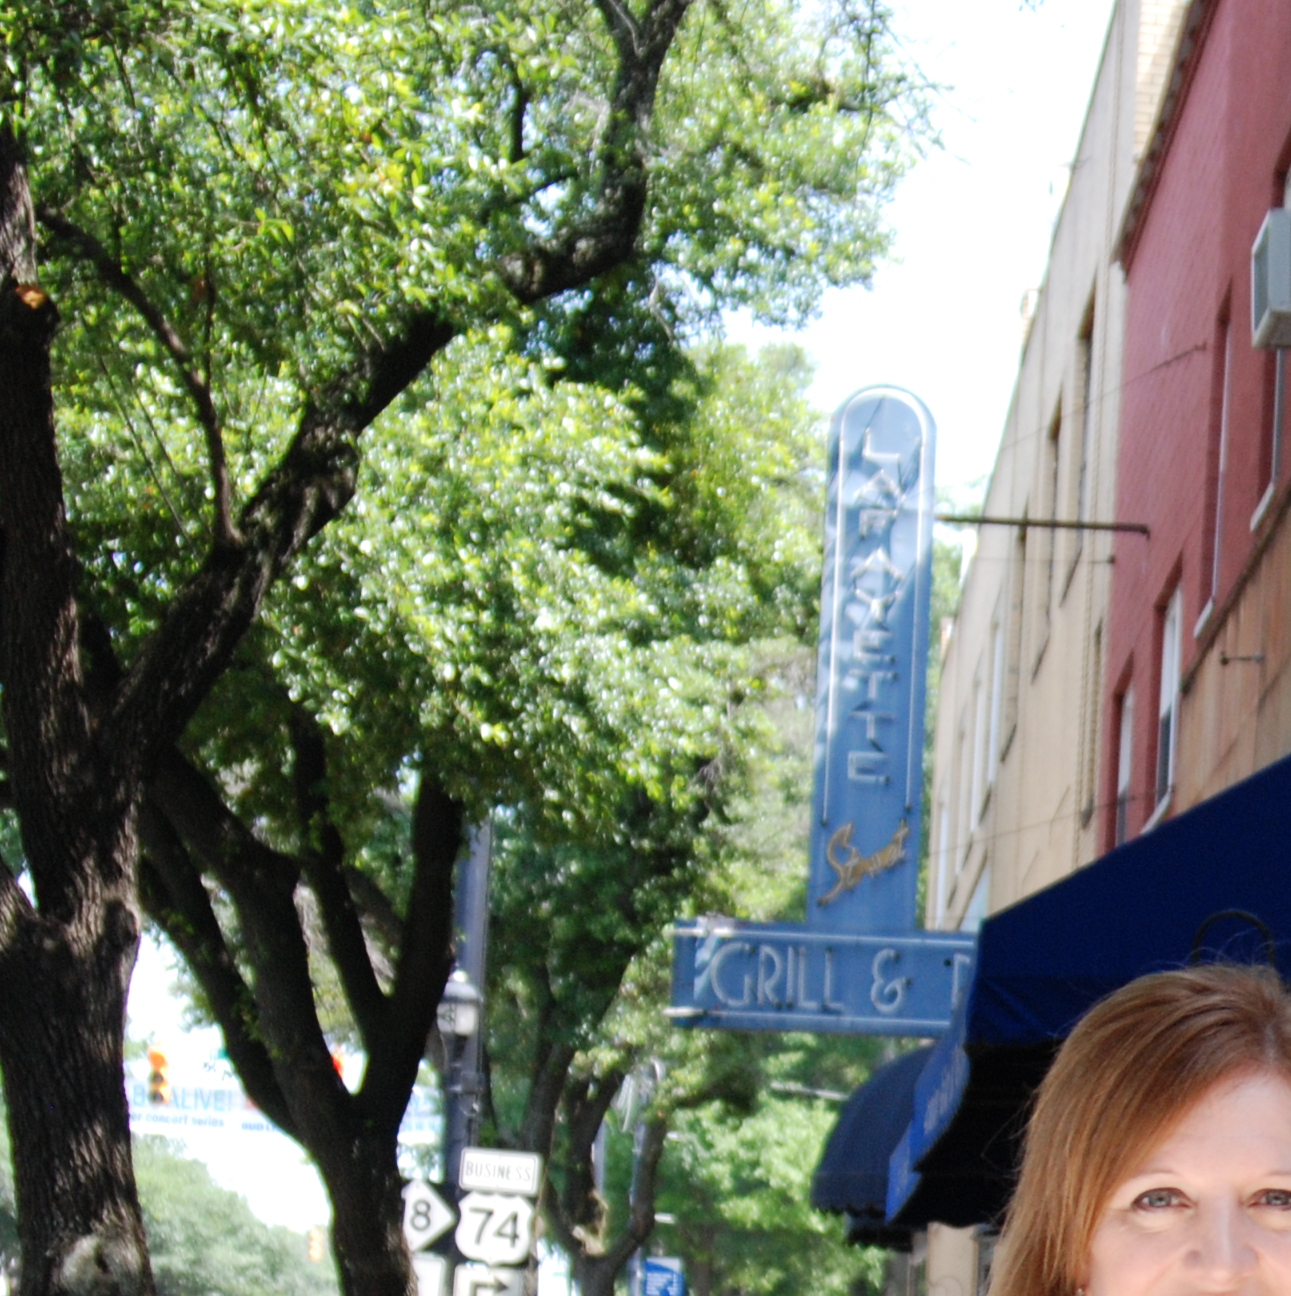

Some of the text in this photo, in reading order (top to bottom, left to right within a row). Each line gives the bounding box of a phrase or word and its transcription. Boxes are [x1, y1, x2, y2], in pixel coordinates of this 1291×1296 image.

[848, 427, 907, 785] LAFAYETTE
[711, 942, 843, 1010] GRILL
[870, 949, 909, 1013] &
[465, 1160, 532, 1182] BUSINESS
[410, 1199, 432, 1232] 8
[468, 1206, 520, 1249] 74
